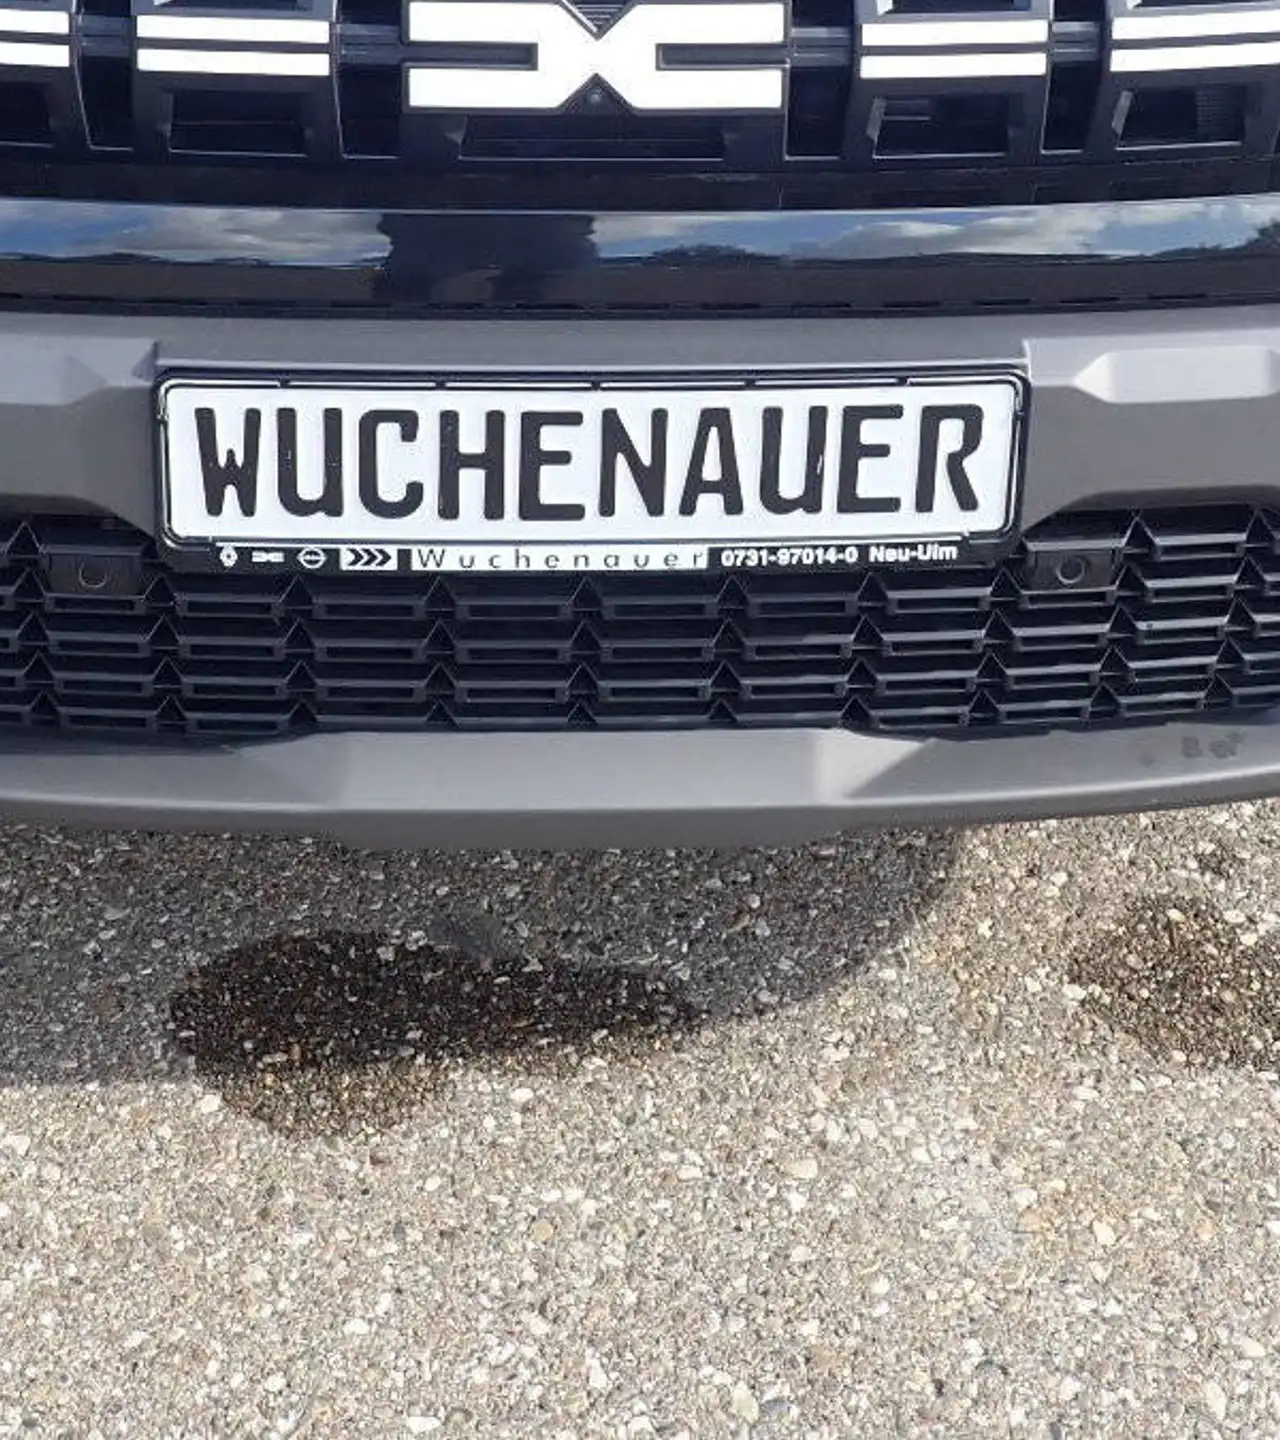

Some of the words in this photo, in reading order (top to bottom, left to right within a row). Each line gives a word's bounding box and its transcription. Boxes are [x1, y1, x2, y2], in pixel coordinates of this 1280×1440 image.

[195, 404, 984, 520] WUCHENAUER
[417, 547, 705, 570] Wuchenauer
[721, 549, 858, 567] 0731-97014-0
[869, 544, 959, 563] Neu-Ulm
